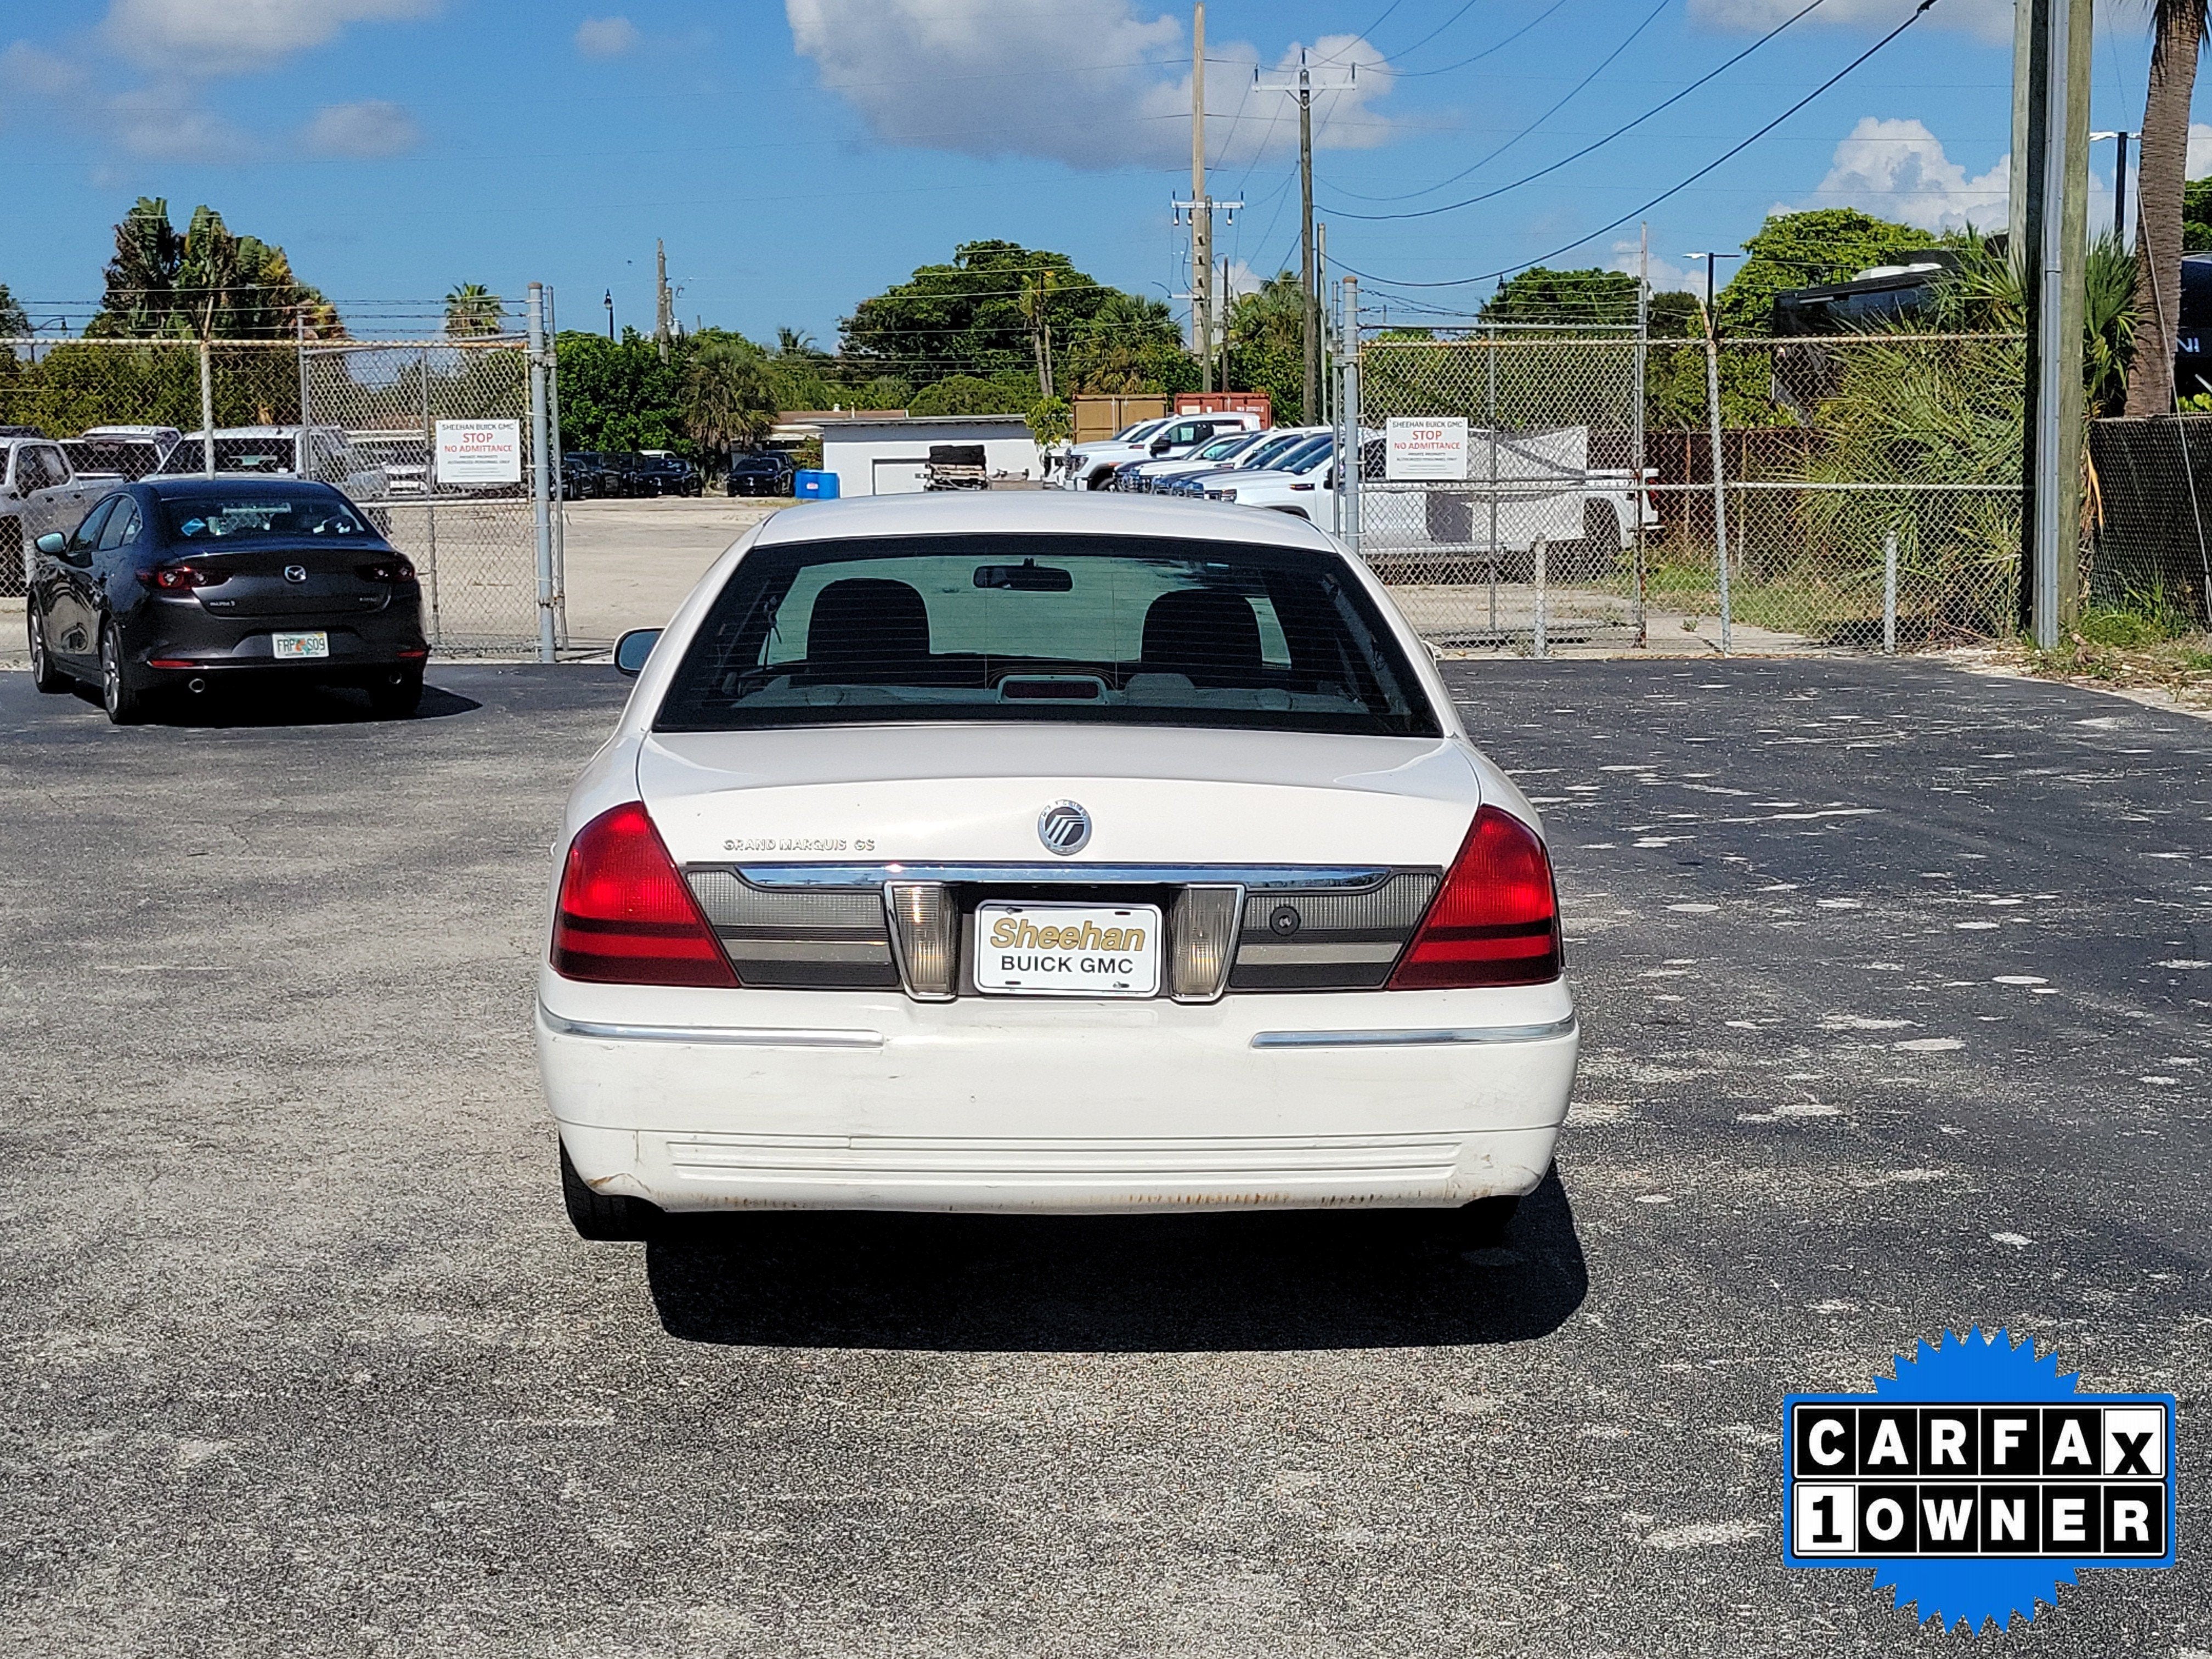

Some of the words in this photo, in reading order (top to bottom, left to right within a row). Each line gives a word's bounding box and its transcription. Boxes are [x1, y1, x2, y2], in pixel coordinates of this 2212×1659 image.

[463, 433, 493, 443] STOP
[1412, 431, 1442, 440] STOP
[723, 839, 776, 851] GRAND
[779, 839, 847, 851] MARQUIS
[854, 839, 876, 851] GS
[990, 917, 1146, 951] Sheehan
[1001, 955, 1073, 973] BUICK
[1080, 958, 1133, 974] GMC
